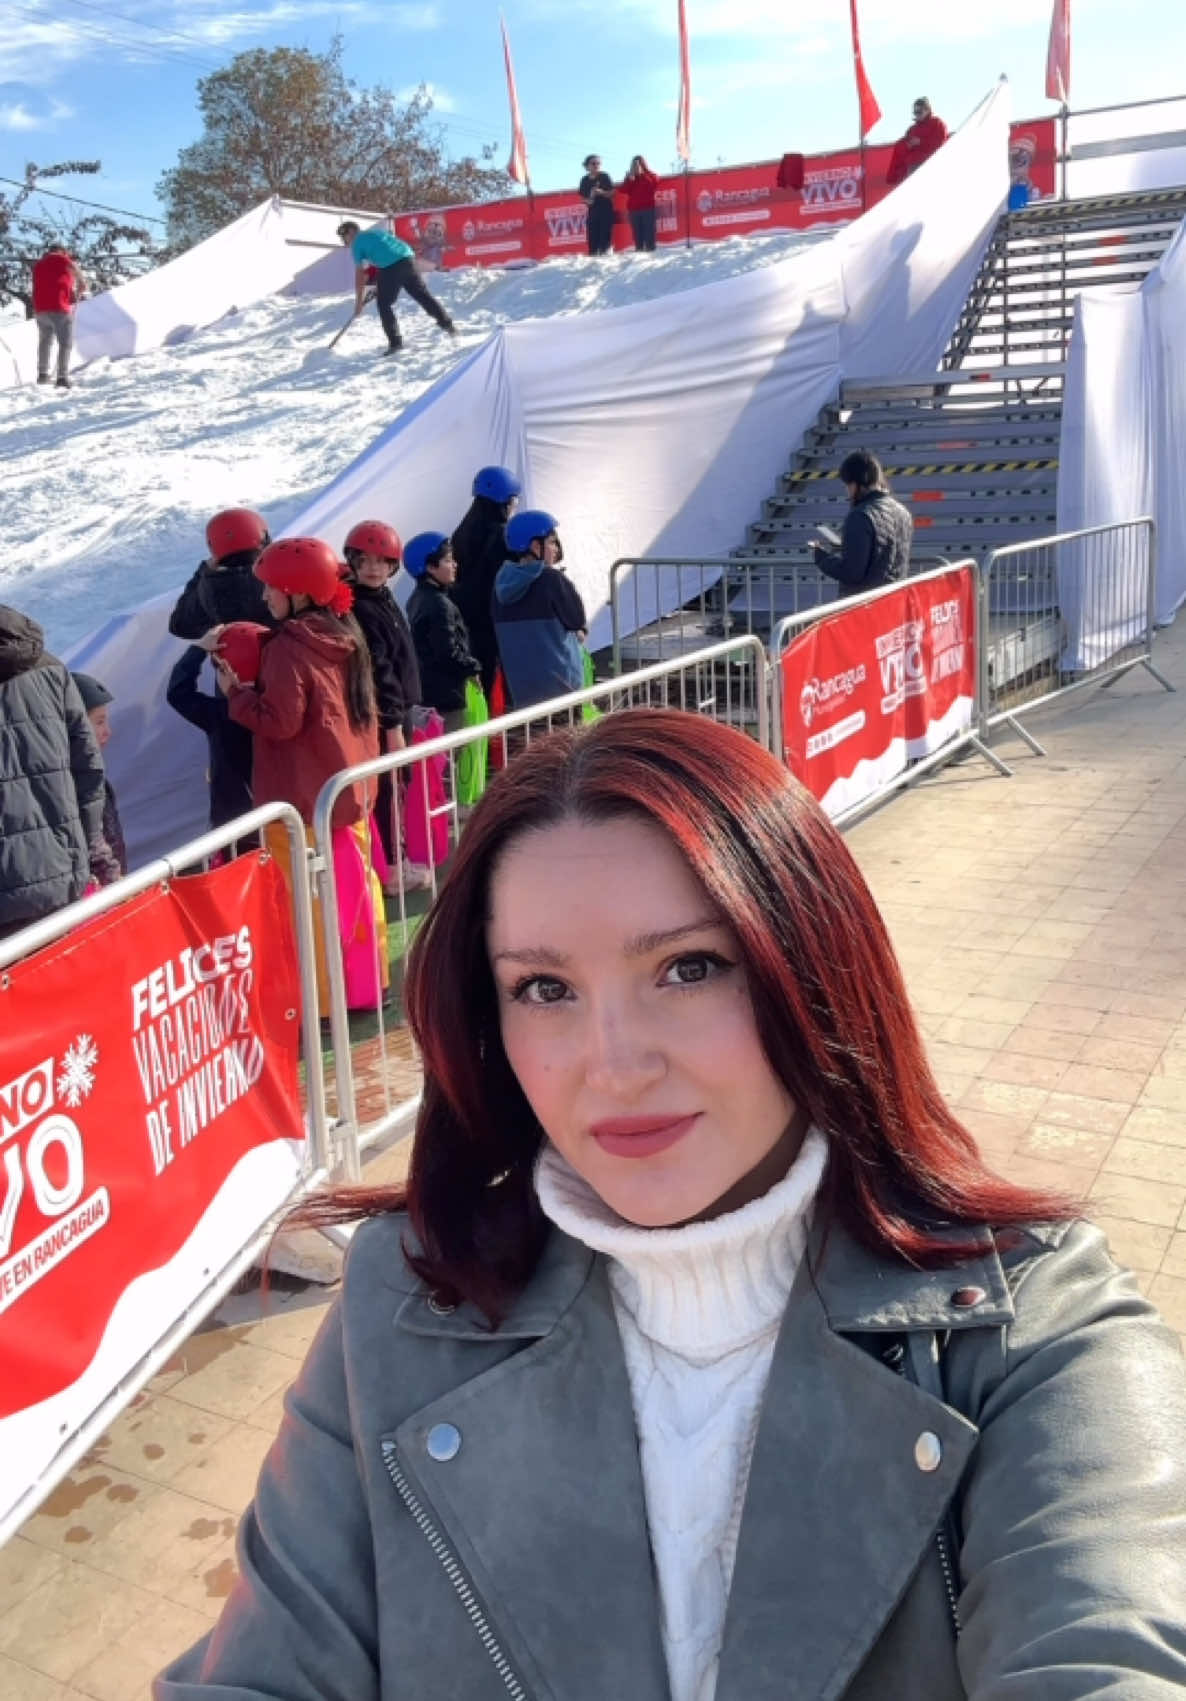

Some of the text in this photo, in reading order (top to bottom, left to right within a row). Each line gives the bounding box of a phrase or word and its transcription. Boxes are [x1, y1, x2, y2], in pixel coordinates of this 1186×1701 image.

[800, 180, 857, 205] VIVO
[812, 664, 866, 702] Rancagua
[131, 925, 253, 1031] FELICES
[146, 1035, 264, 1177] DE INVIERNO
[13, 1254, 33, 1287] EN
[35, 1198, 104, 1270] RANCAGUA
